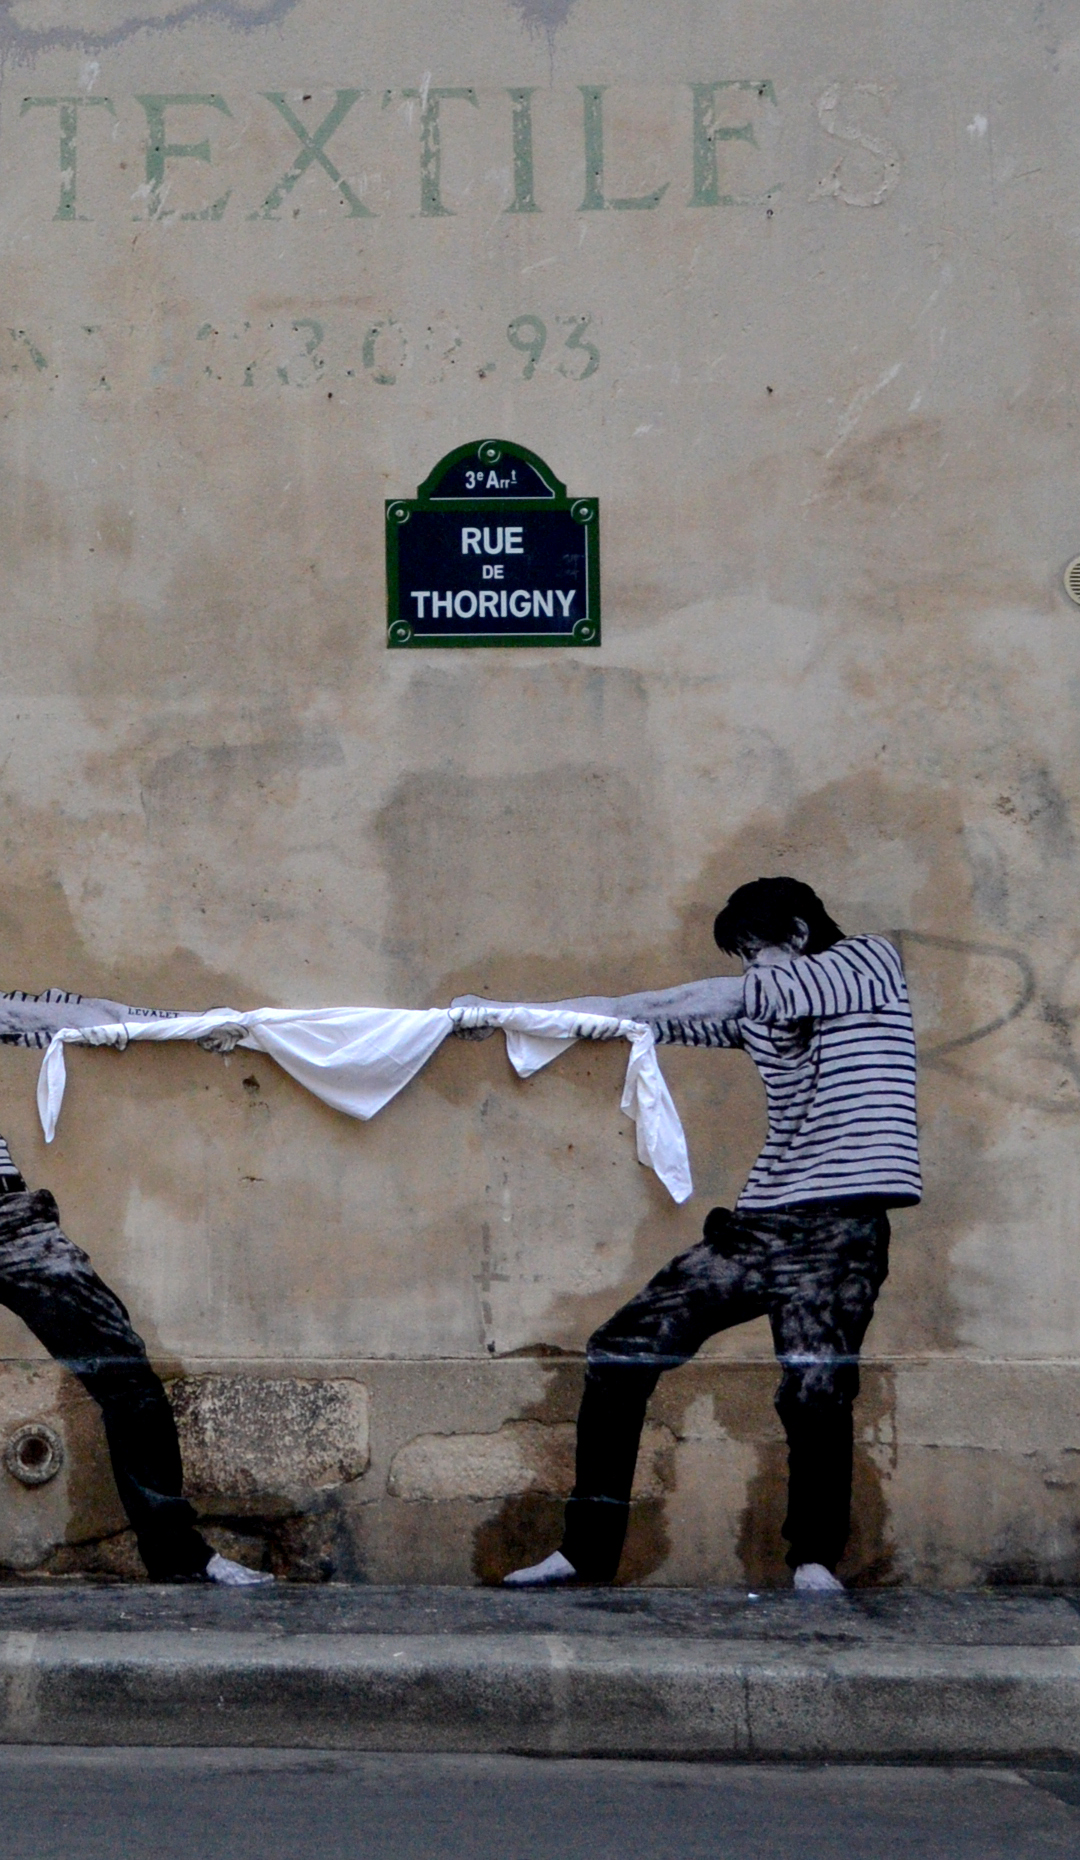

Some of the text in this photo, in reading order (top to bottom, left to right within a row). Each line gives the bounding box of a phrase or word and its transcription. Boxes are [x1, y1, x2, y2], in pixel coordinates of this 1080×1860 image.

[20, 79, 901, 222] TEXTILES
[461, 526, 524, 555] RUE
[482, 564, 505, 580] DE
[410, 589, 577, 619] THORIGNY
[127, 1007, 180, 1019] LEVALET
